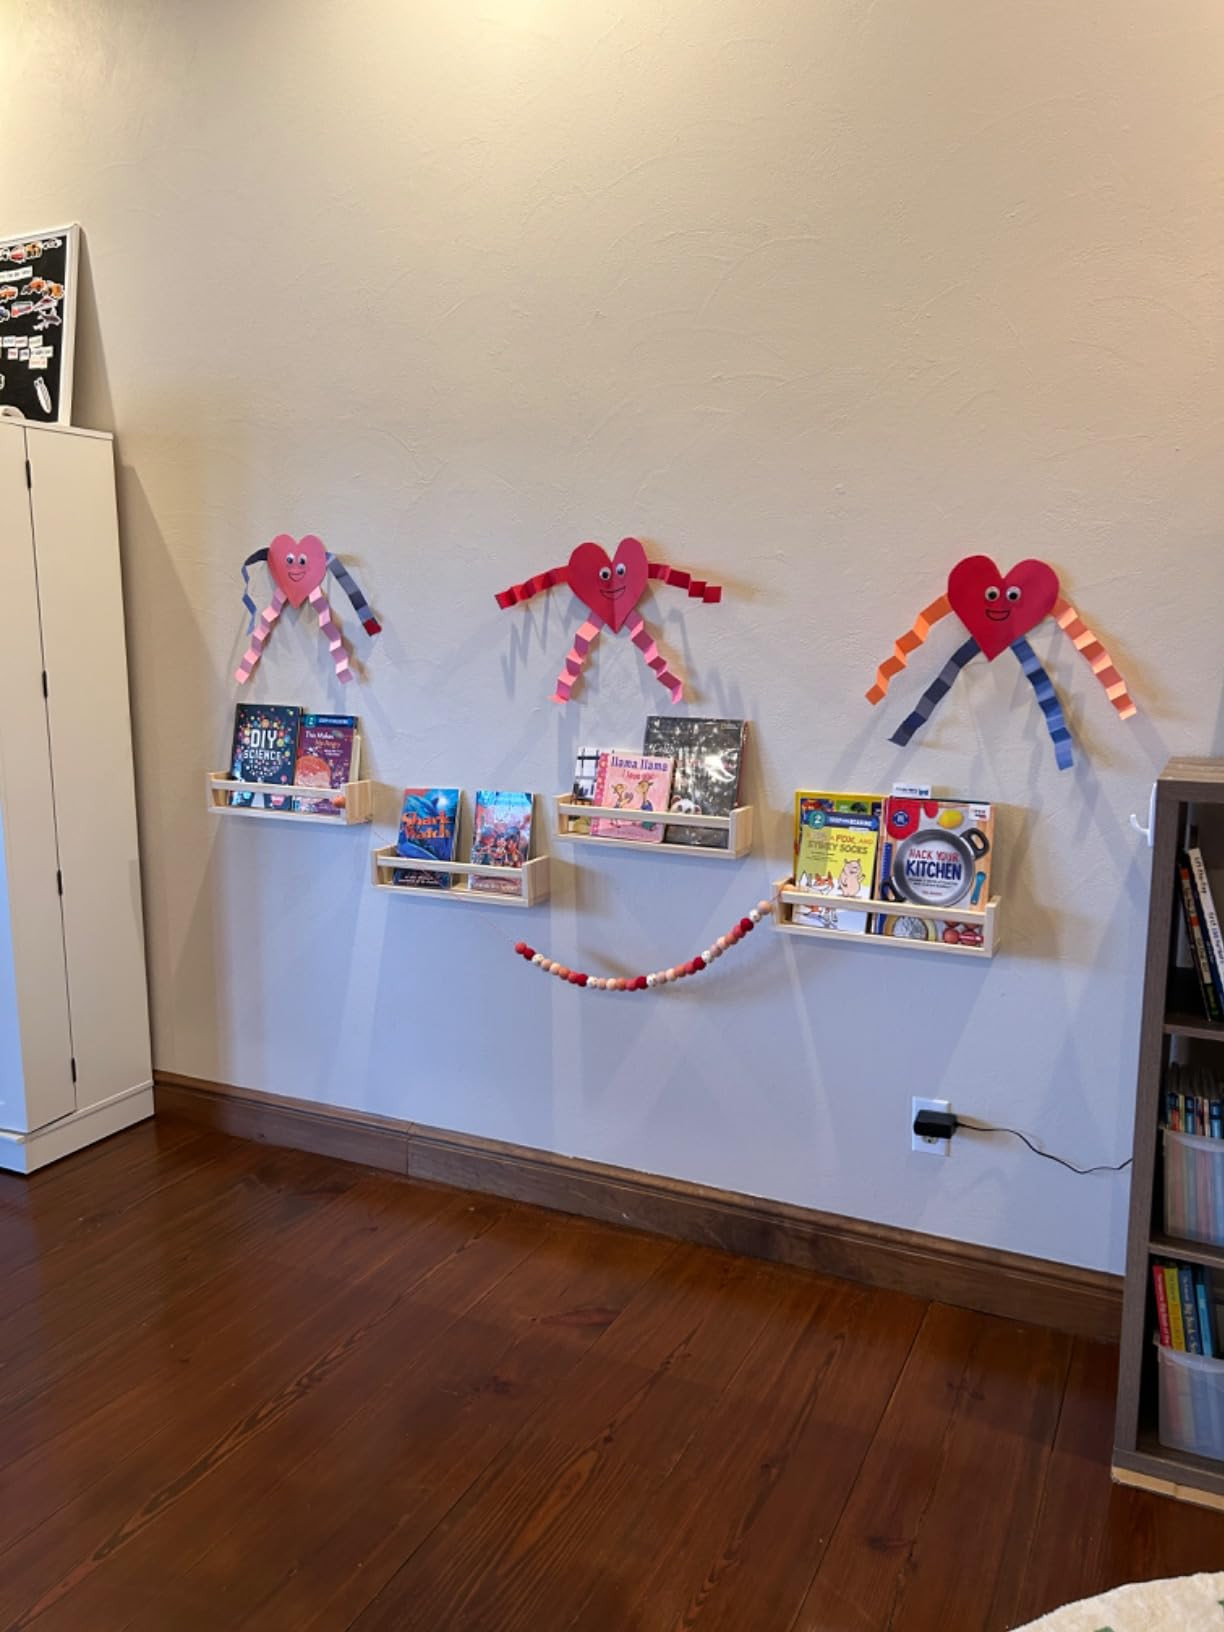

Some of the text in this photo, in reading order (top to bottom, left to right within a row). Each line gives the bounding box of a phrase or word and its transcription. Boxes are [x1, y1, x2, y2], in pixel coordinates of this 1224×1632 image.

[250, 729, 277, 749] DIY
[244, 749, 281, 760] SCIENCE
[611, 756, 669, 772] llama llama
[402, 810, 449, 826] Shark
[814, 814, 821, 824] 2
[839, 843, 869, 855] SOCKS
[908, 848, 960, 863] HACK YOUR
[905, 859, 962, 881] KITCHEN
